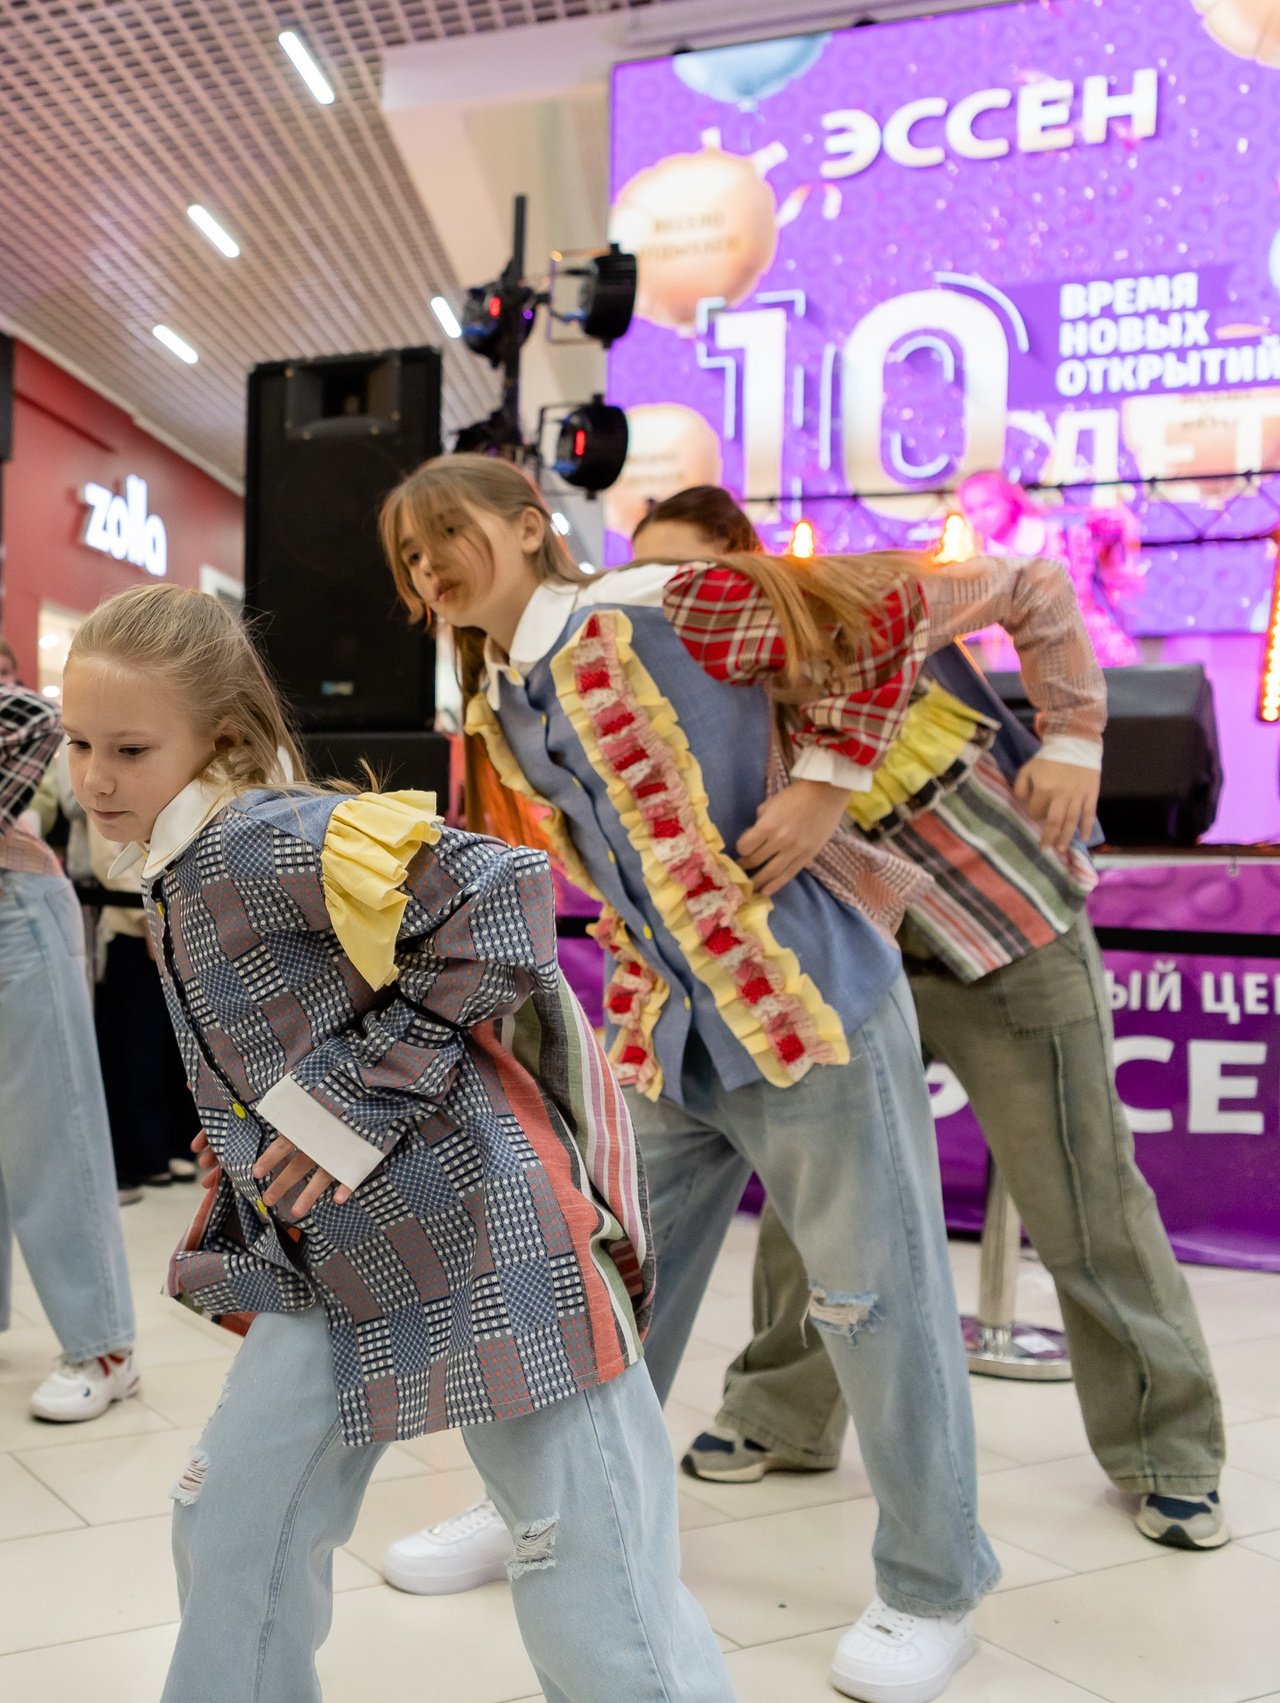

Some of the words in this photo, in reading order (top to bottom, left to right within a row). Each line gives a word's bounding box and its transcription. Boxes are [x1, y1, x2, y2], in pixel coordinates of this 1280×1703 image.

[820, 68, 1158, 179] ЭССЕН
[1058, 309, 1210, 358] НОВЫХ
[1059, 271, 1198, 320] ВРЕМЯ
[714, 286, 1009, 524] 10
[82, 474, 168, 577] zolla
[1103, 959, 1182, 1013] ЫЙ
[1202, 970, 1280, 1025] ЦЕ
